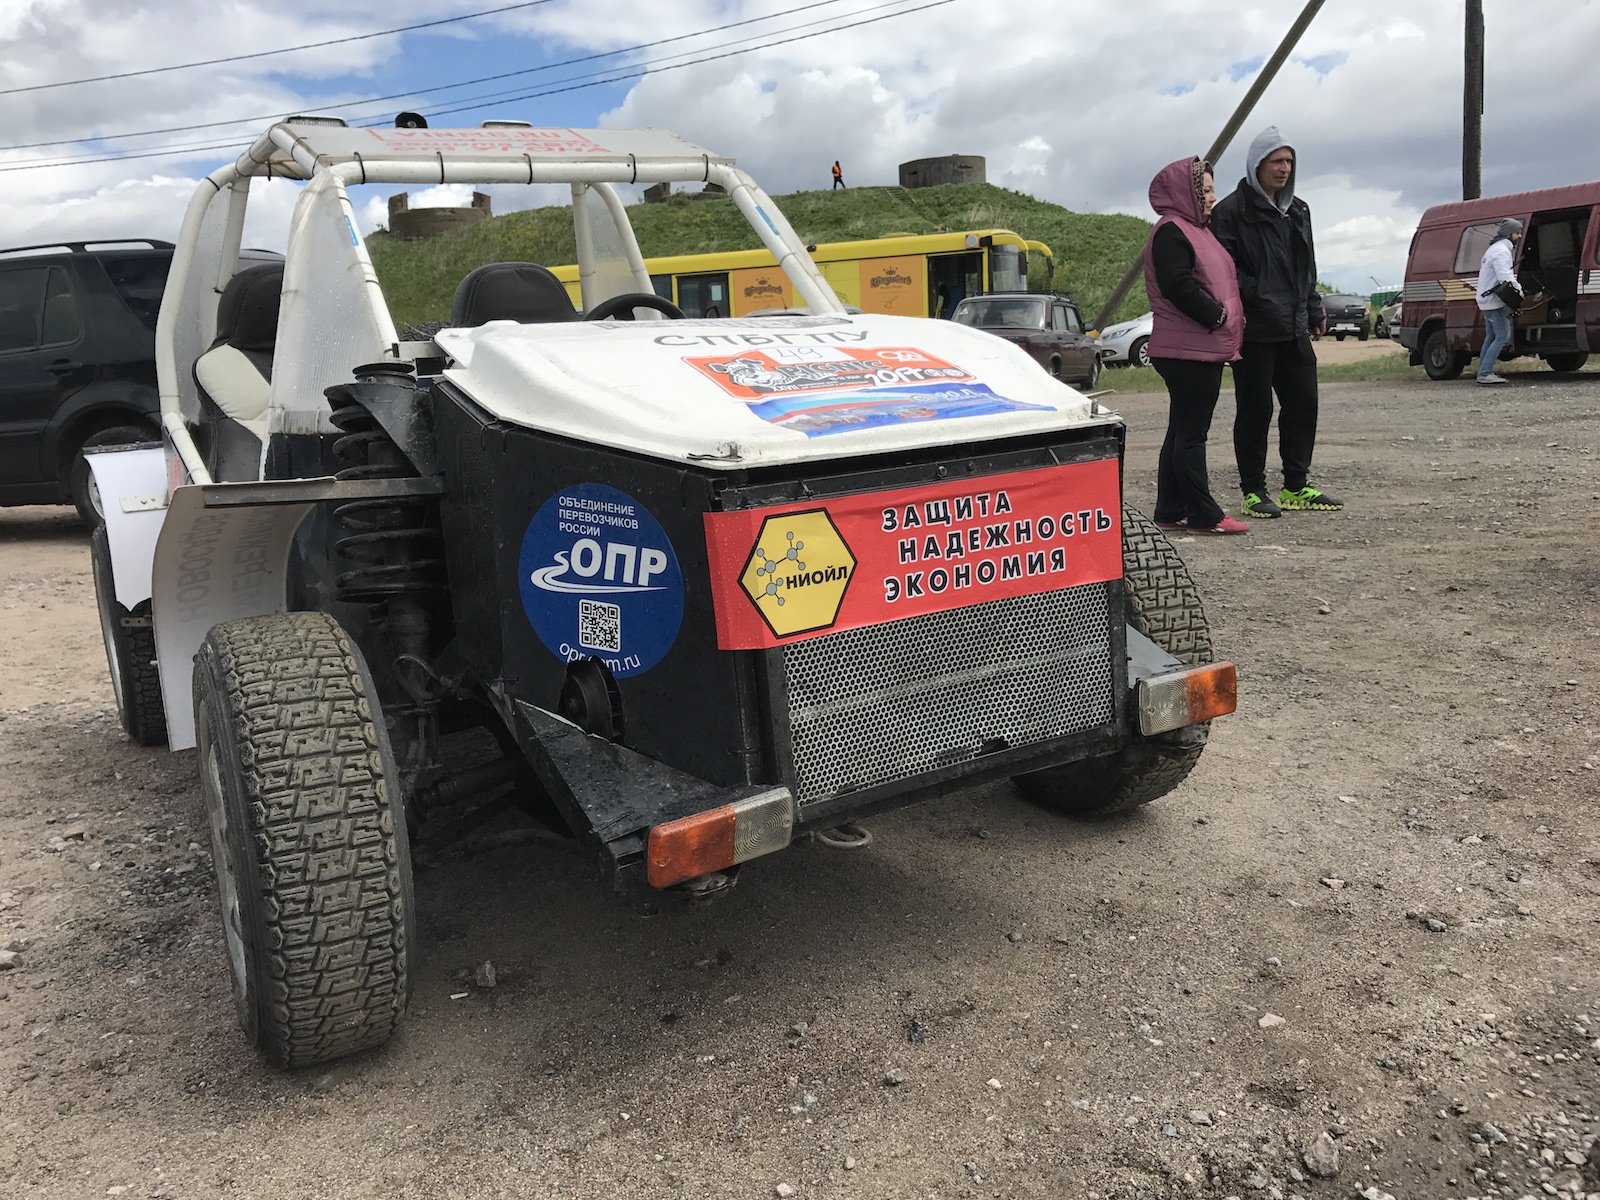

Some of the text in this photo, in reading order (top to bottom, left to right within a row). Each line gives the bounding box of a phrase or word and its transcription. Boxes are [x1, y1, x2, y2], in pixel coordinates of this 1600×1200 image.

[864, 367, 925, 386] 2017
[558, 496, 635, 516] ОБЪЕДИНЕНИЕ
[880, 490, 1012, 532] ЗАЩИТА
[558, 509, 639, 530] ПЕРЕВОЗЧИКОВ
[558, 522, 601, 537] РОССИИ
[898, 508, 1112, 565] НАДЕЖНОСТЬ
[570, 538, 668, 587] ОПР
[884, 547, 1066, 602] ЭКОНОМИЯ
[785, 565, 848, 590] НИОЙЛ
